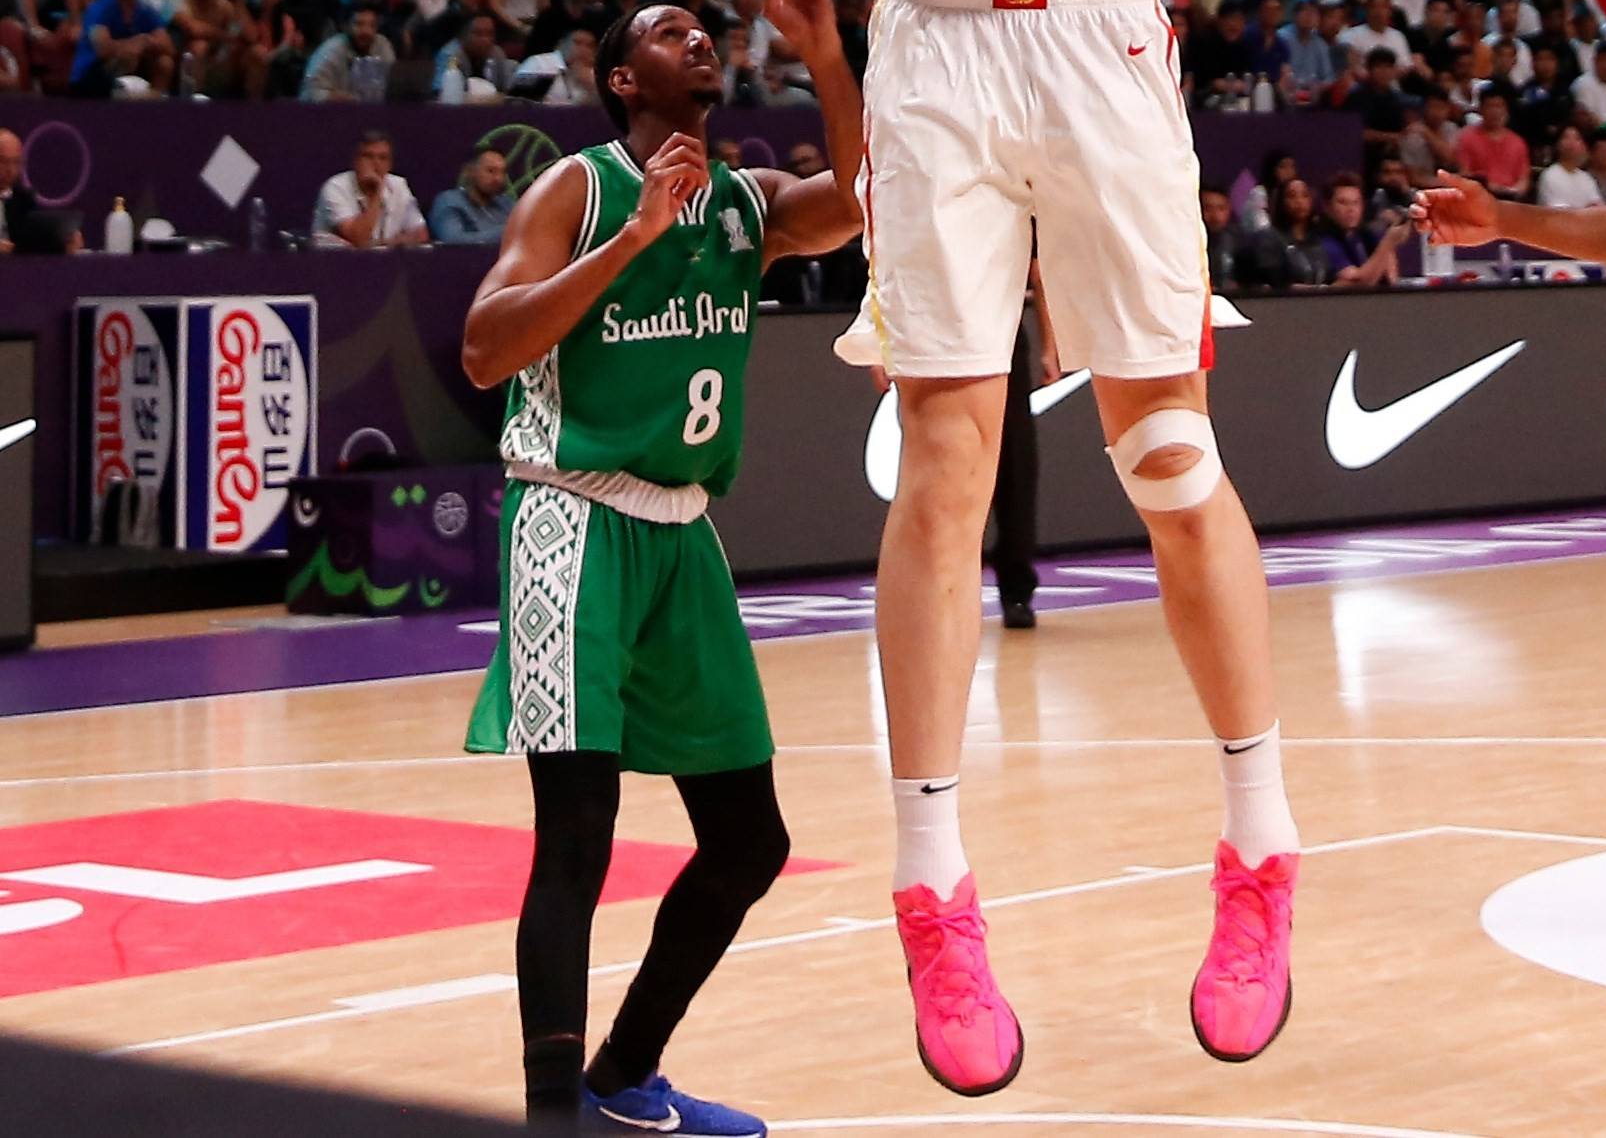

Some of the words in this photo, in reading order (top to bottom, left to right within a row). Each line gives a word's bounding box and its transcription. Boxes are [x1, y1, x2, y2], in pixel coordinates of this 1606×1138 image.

[602, 295, 693, 343] Saudi
[262, 342, 292, 489] 百岁山
[682, 367, 724, 446] 8
